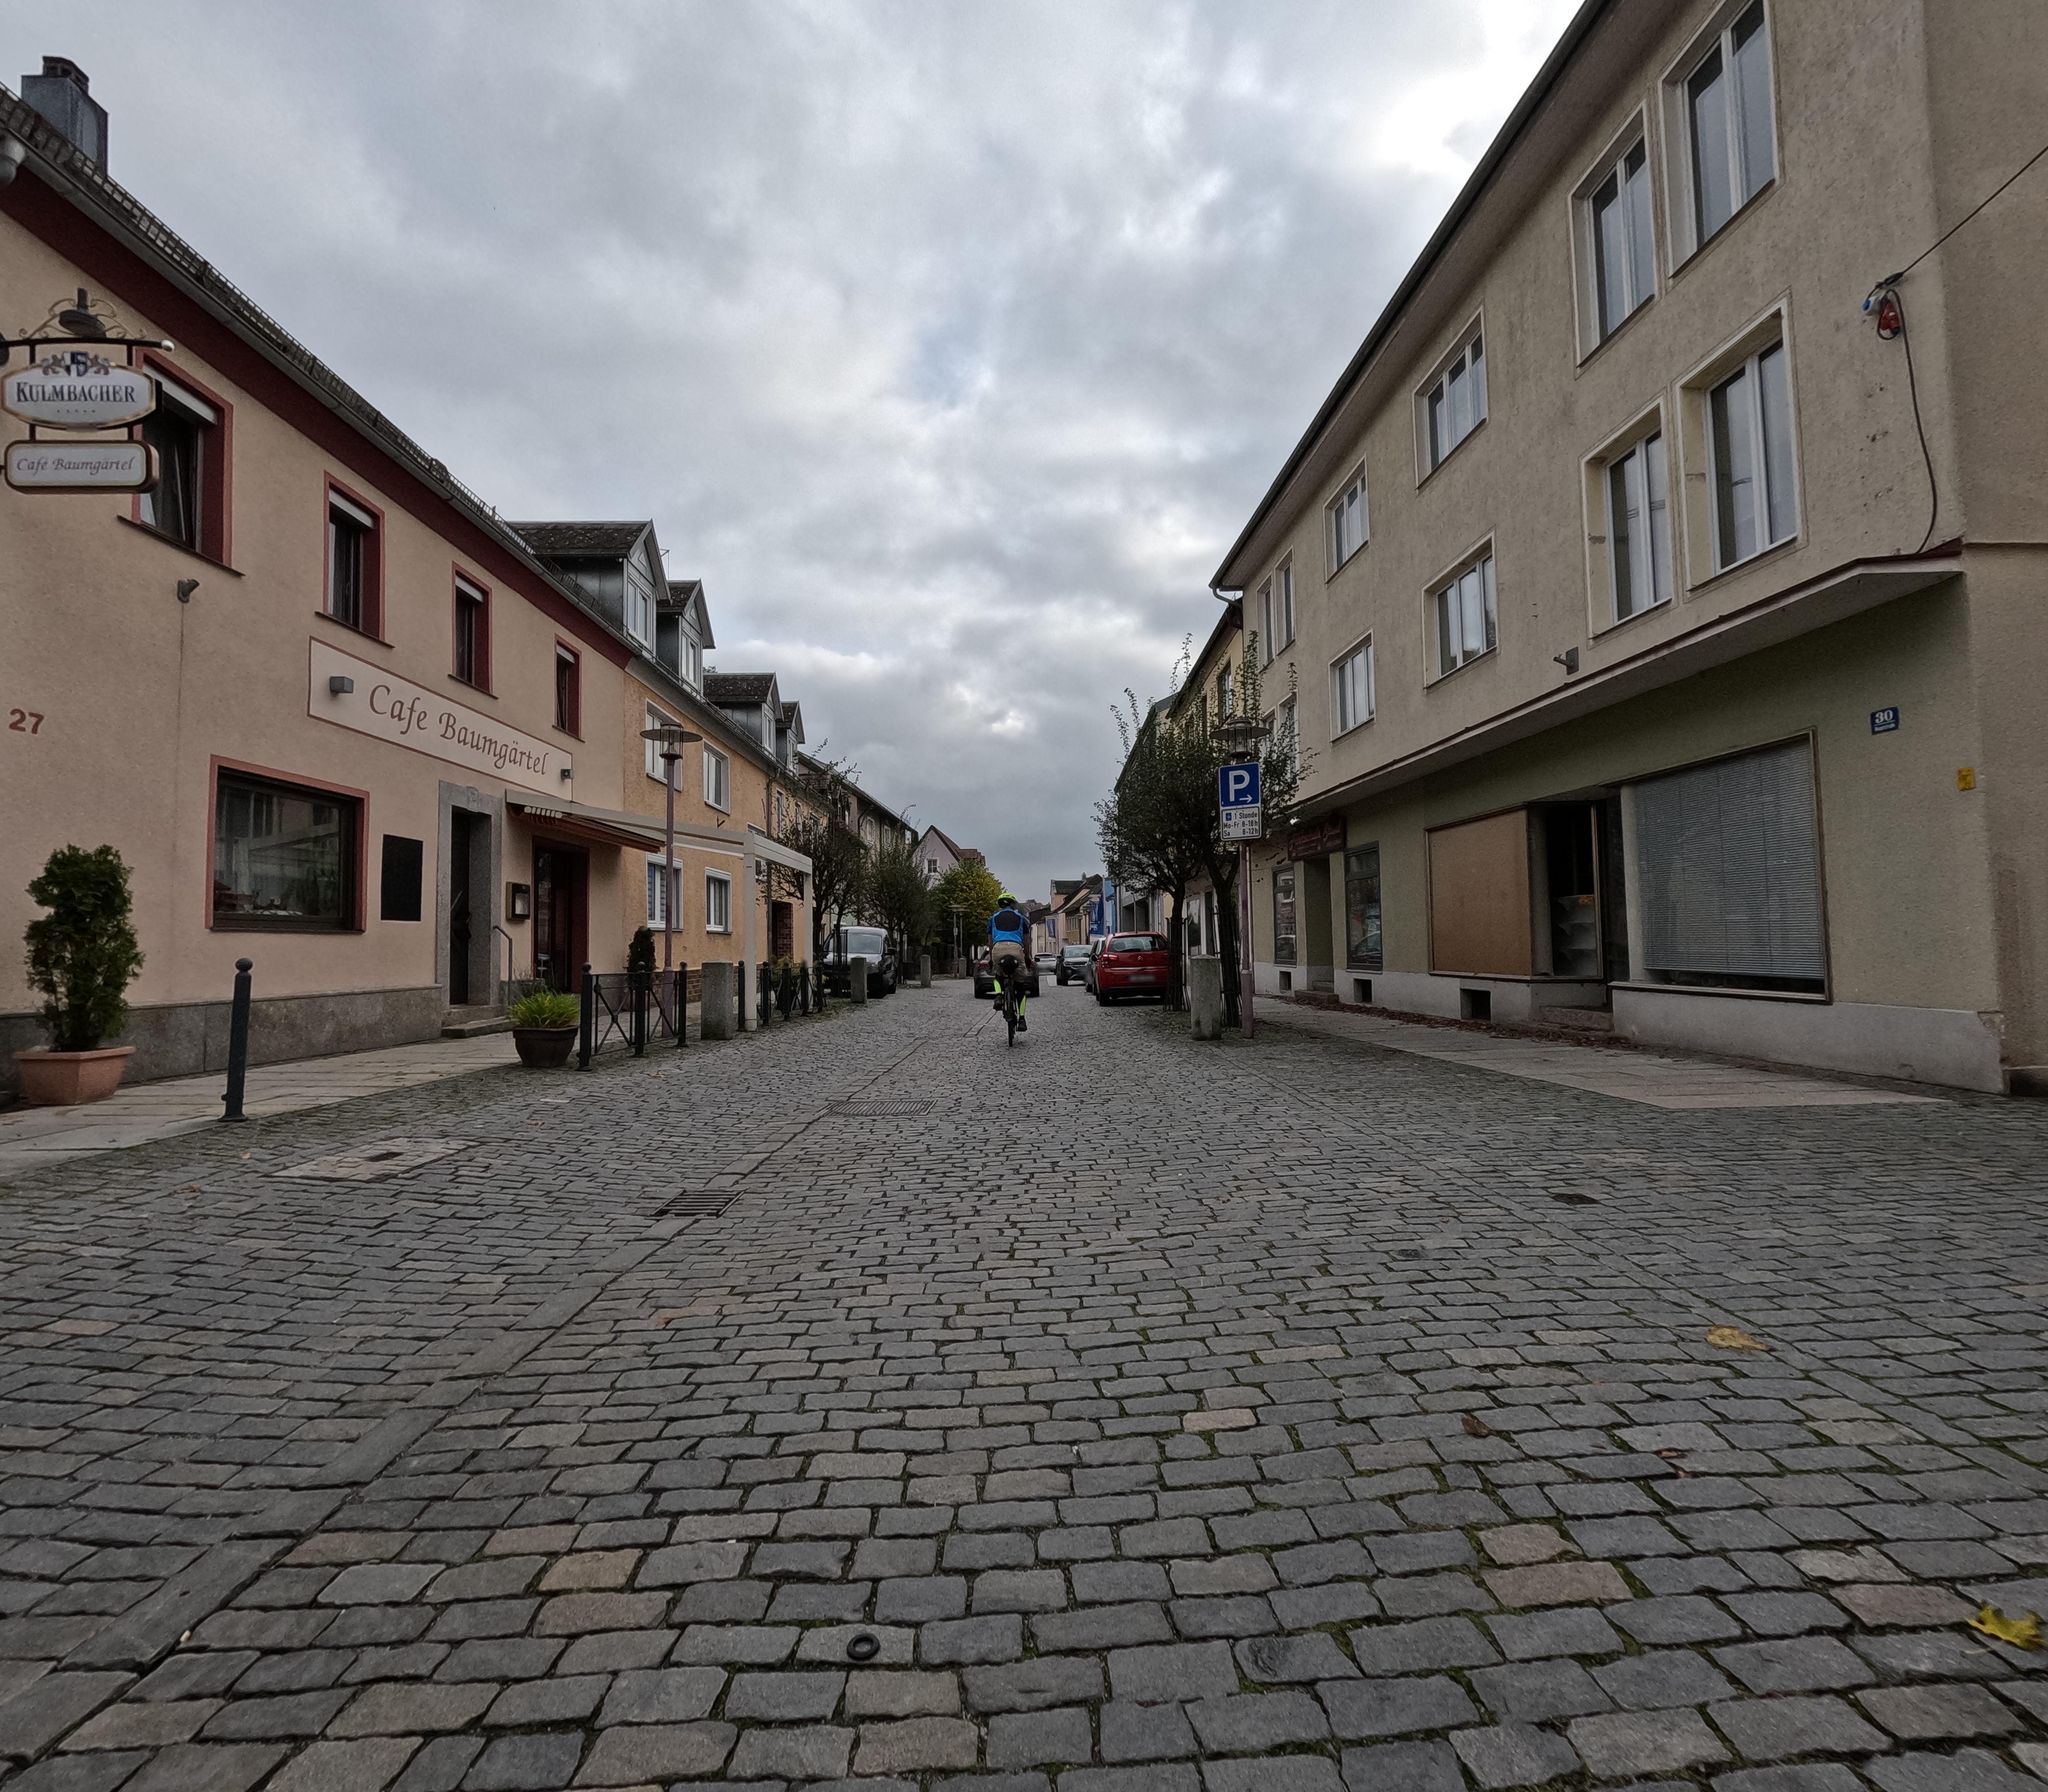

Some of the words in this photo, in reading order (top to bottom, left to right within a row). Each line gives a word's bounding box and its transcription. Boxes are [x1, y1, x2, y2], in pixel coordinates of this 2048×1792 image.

[16, 381, 136, 403] KULMBACHER
[52, 456, 135, 475] Baumgärtel
[9, 708, 44, 735] 27
[1875, 709, 1894, 724] 30
[369, 684, 428, 735] Cafe
[438, 711, 549, 775] Baumgärtel
[1229, 770, 1250, 802] P
[1224, 821, 1240, 829] Mo-Fr
[1239, 811, 1257, 819] Stunde
